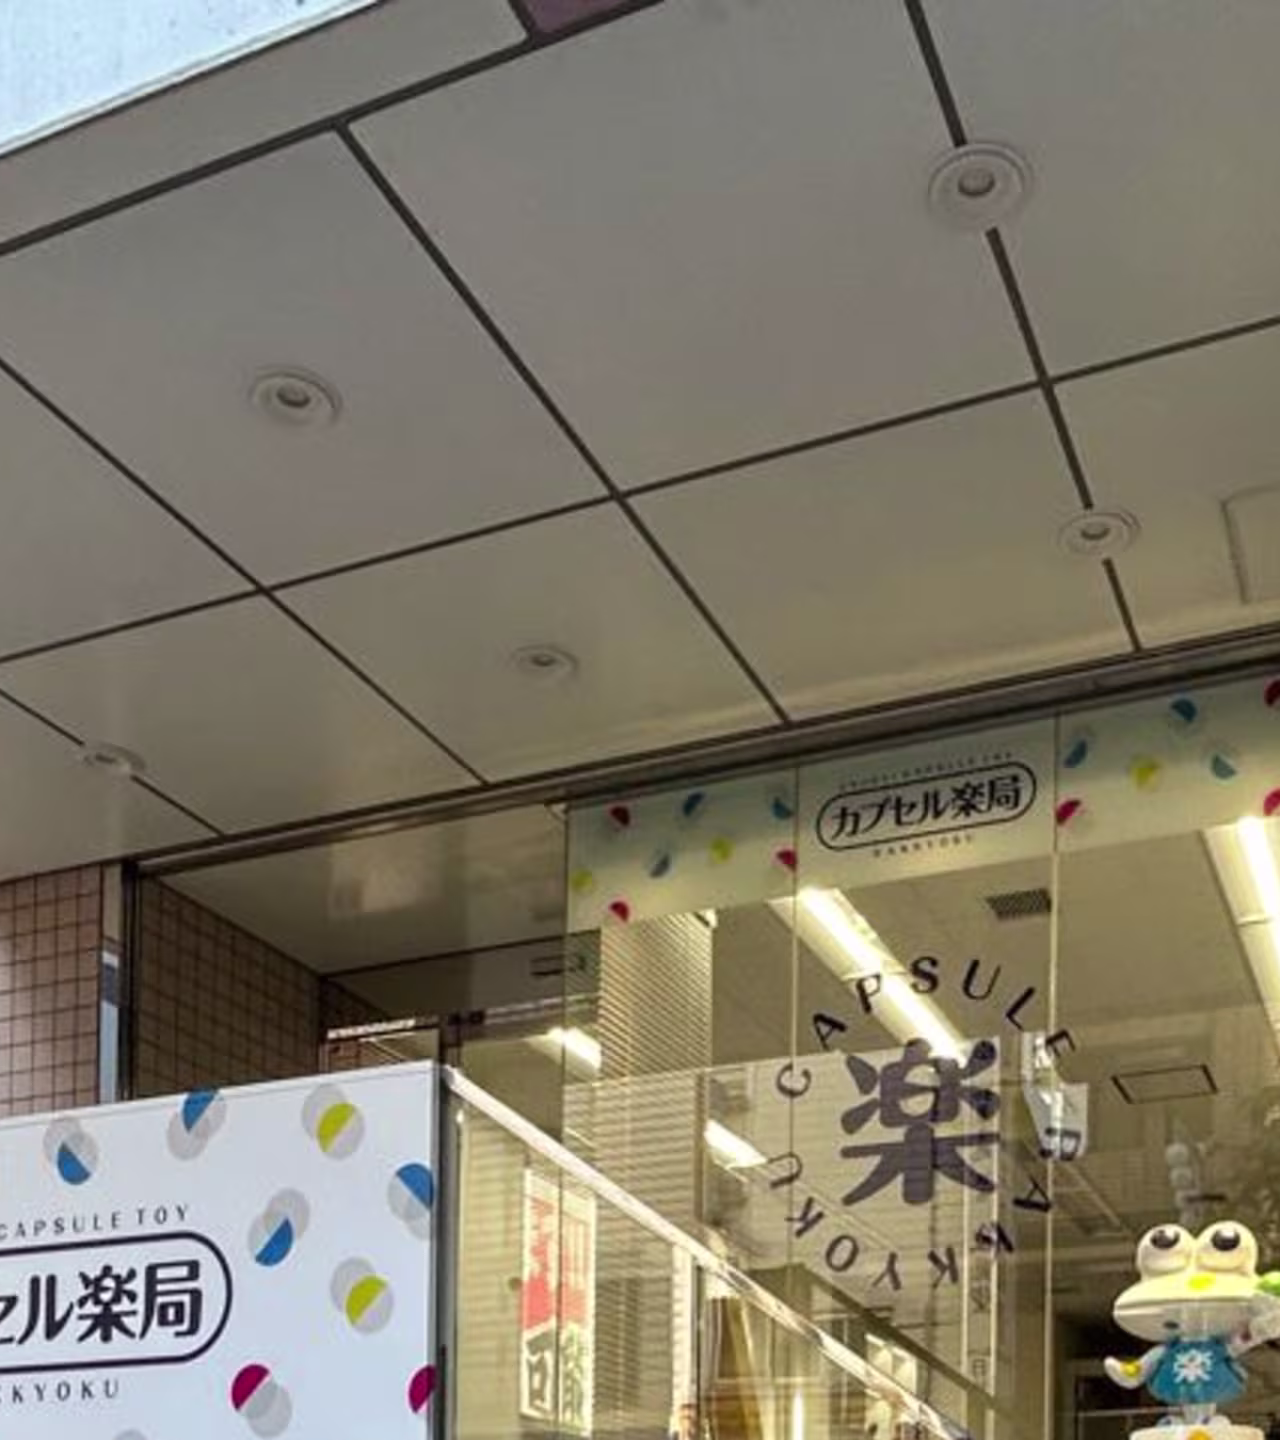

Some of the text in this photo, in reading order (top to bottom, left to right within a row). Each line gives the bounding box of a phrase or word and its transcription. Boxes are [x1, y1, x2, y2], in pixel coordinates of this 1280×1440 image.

[830, 774, 1021, 840] カプセル楽局
[775, 956, 1075, 1098] CAPSULE
[839, 1037, 1002, 1206] 楽
[135, 1203, 191, 1226] TOY
